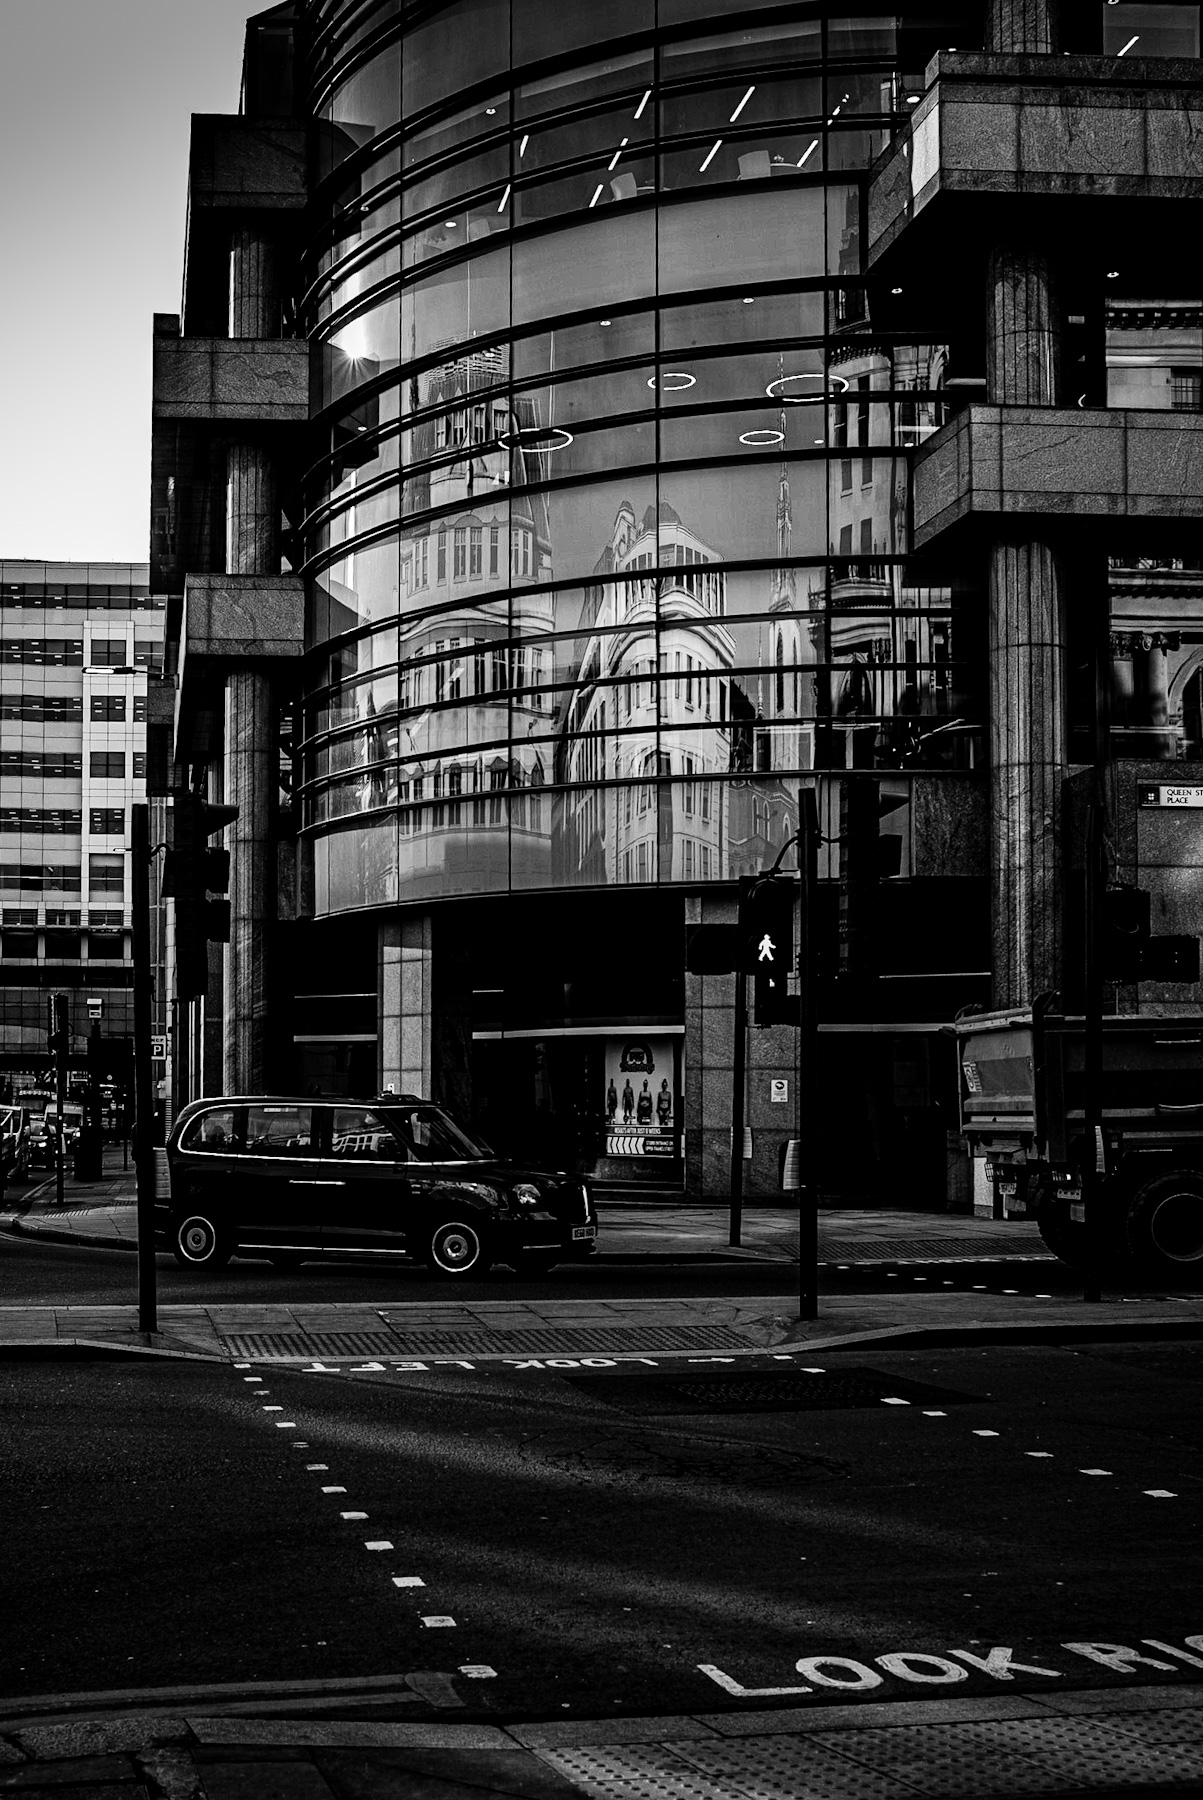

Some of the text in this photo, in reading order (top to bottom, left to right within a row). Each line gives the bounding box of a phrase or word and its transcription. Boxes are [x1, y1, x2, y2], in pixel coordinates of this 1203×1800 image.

[1166, 788, 1191, 796] QUEEN
[154, 1045, 162, 1055] P
[302, 1358, 659, 1373] LOOK LEFT
[696, 1634, 1203, 1696] LOOK RI
